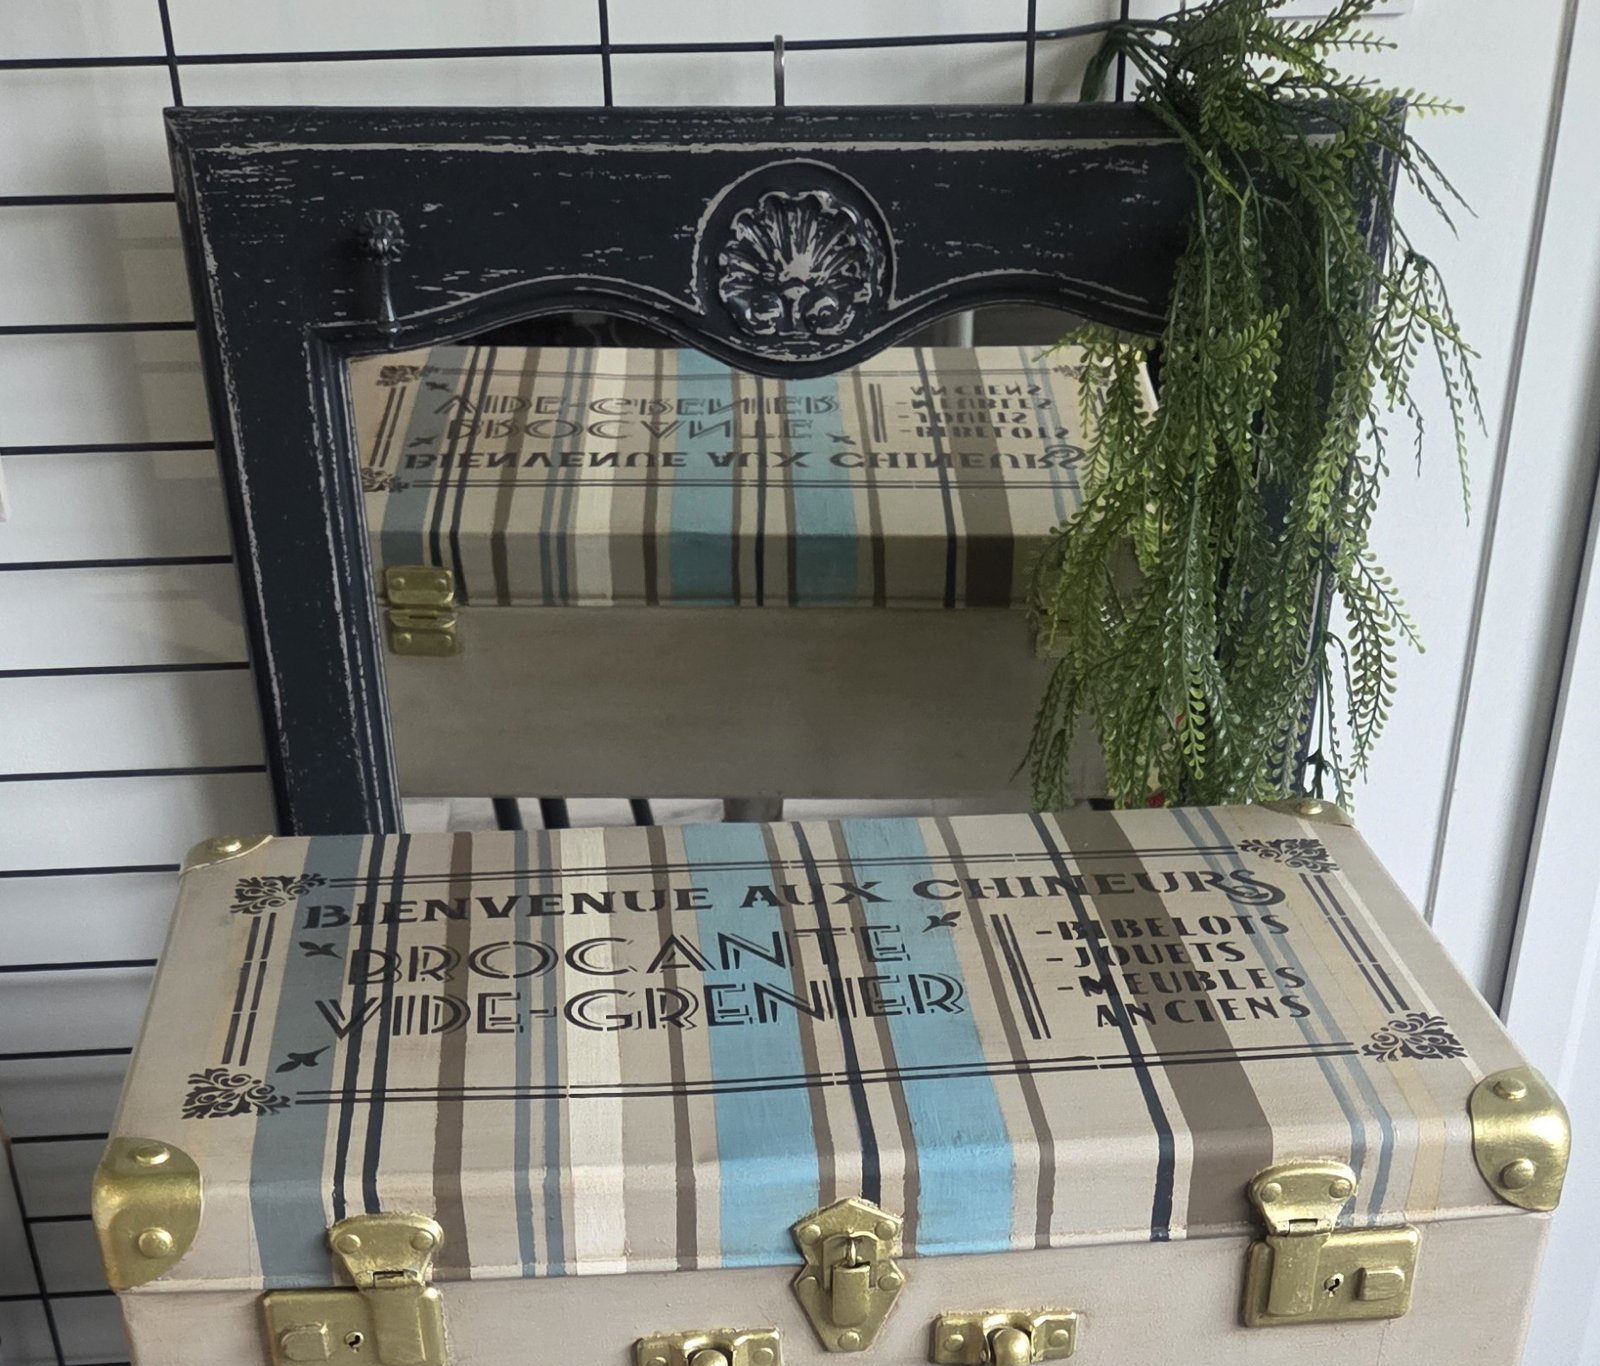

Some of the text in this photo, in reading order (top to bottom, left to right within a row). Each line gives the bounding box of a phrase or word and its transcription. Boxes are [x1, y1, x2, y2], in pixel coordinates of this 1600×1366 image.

[302, 868, 1287, 929] BIENVENUE AUX CHINEURS
[347, 923, 908, 986] BROCANTE
[313, 972, 968, 1040] VIDE-GRENIER
[1095, 994, 1312, 1028] ANCIENS
